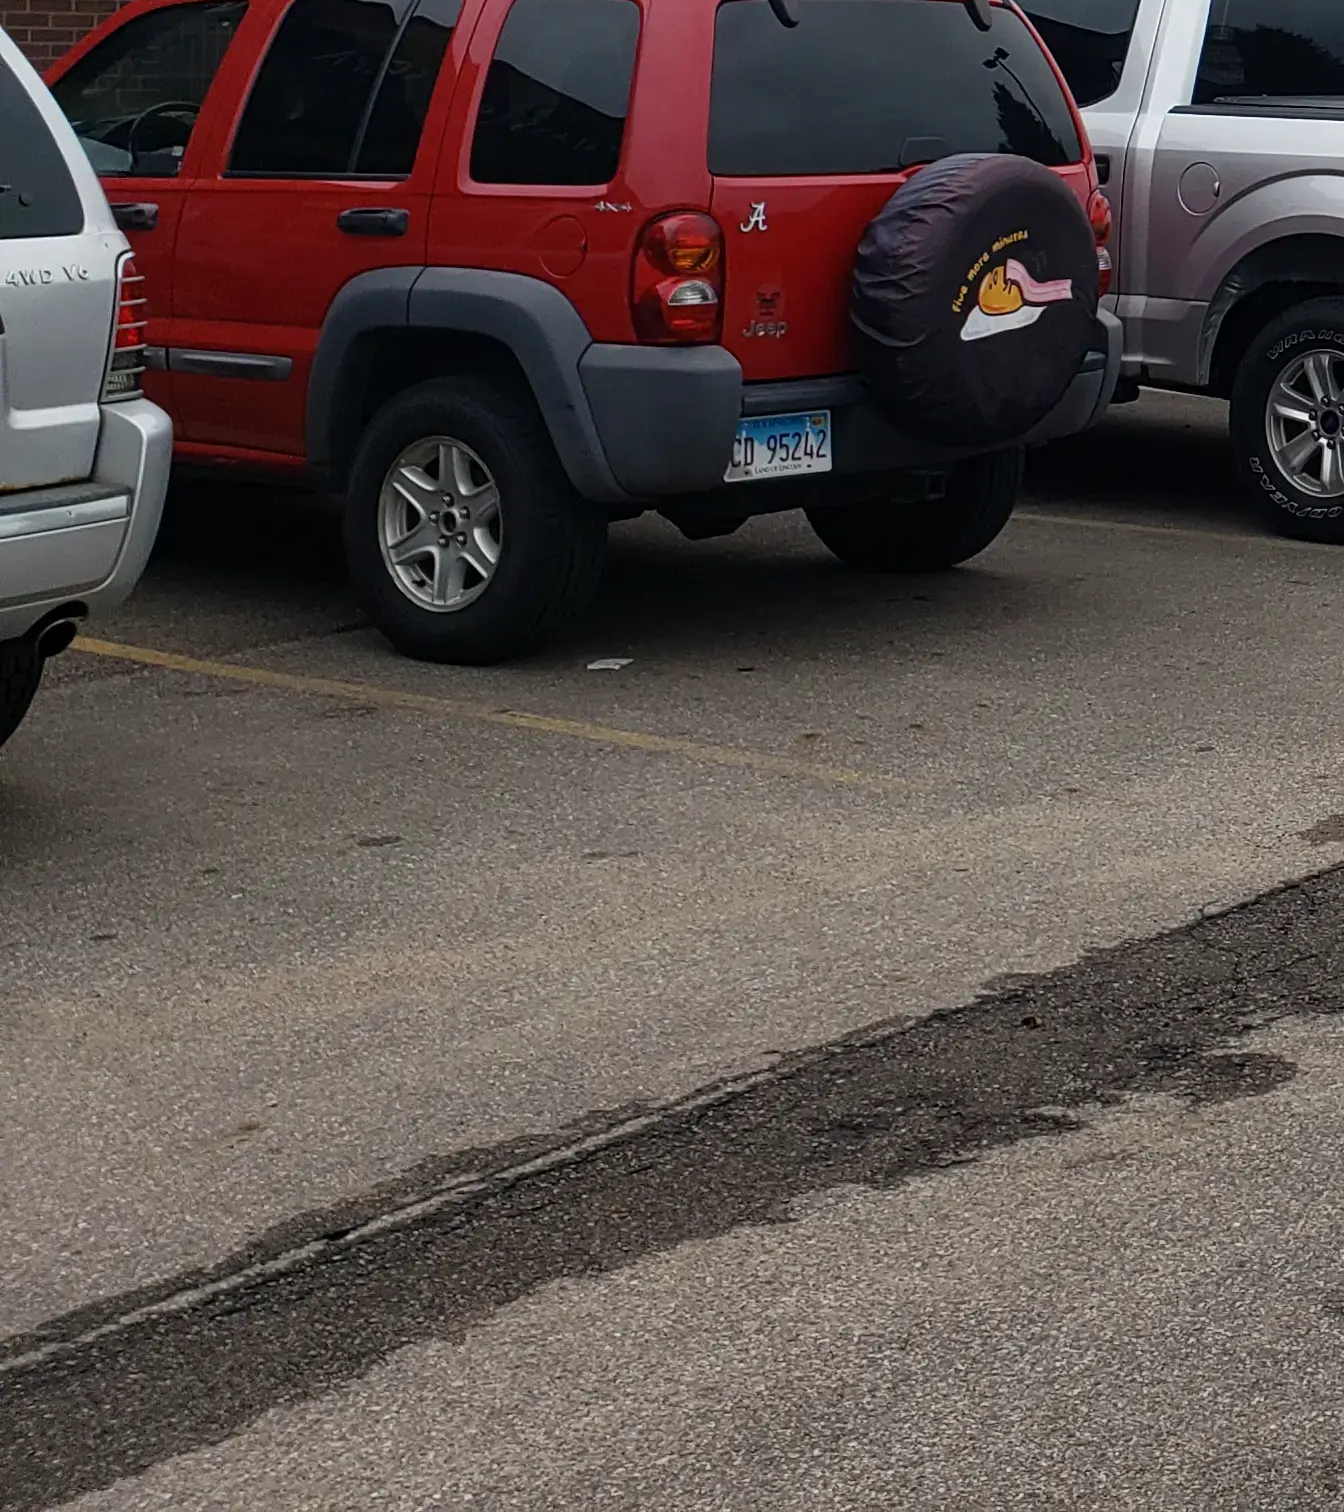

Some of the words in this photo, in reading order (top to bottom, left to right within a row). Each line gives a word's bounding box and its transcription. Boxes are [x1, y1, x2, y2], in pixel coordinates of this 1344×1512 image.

[740, 201, 768, 233] A
[967, 251, 990, 281] more
[991, 229, 1029, 253] minutes
[5, 268, 54, 288] 4WD
[62, 264, 89, 282] V6
[742, 319, 788, 339] Jeep
[731, 436, 755, 469] CD
[766, 428, 828, 465] 95242
